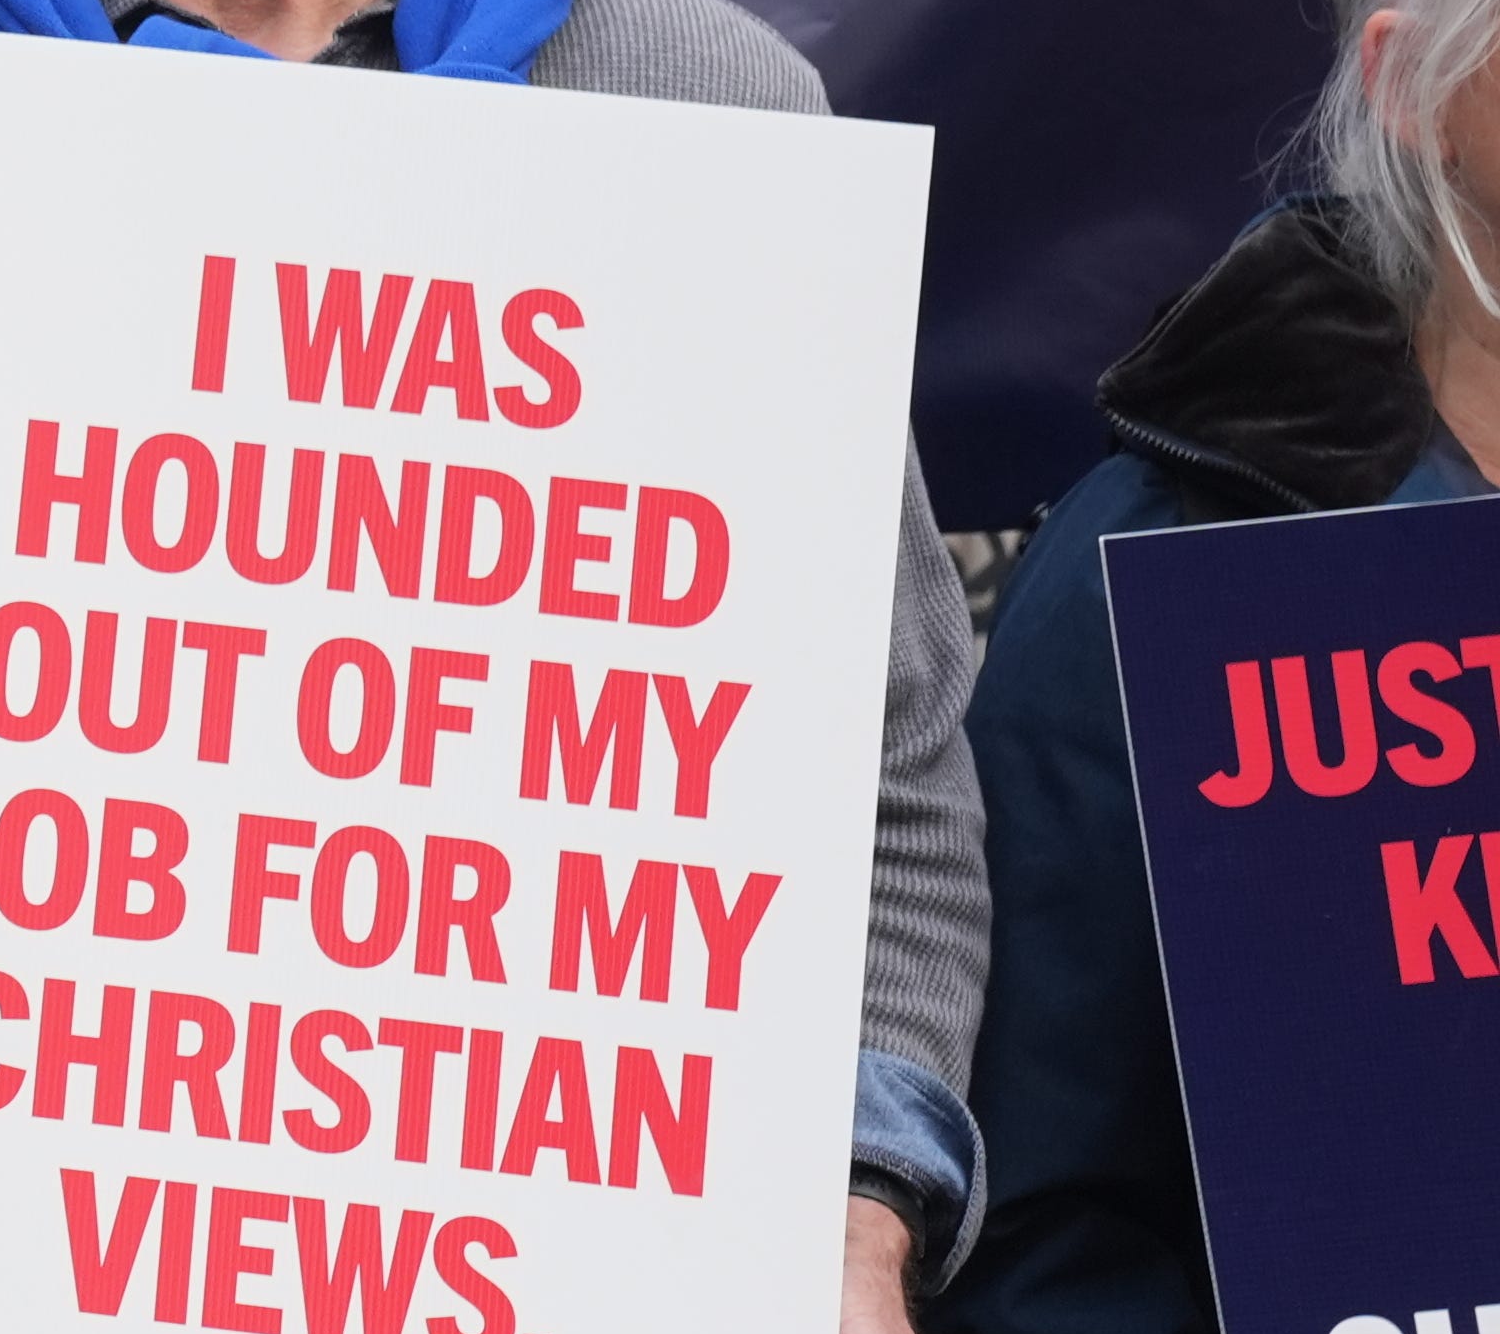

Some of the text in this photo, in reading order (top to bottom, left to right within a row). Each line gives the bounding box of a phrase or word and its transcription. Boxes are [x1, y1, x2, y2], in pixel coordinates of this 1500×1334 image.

[191, 254, 585, 430] I WAS
[14, 418, 731, 629] HOUNDED
[296, 636, 490, 788] OF
[518, 658, 753, 819] MY
[1197, 633, 1500, 808] JUS
[226, 812, 512, 984] FOR
[548, 849, 783, 1012] MY
